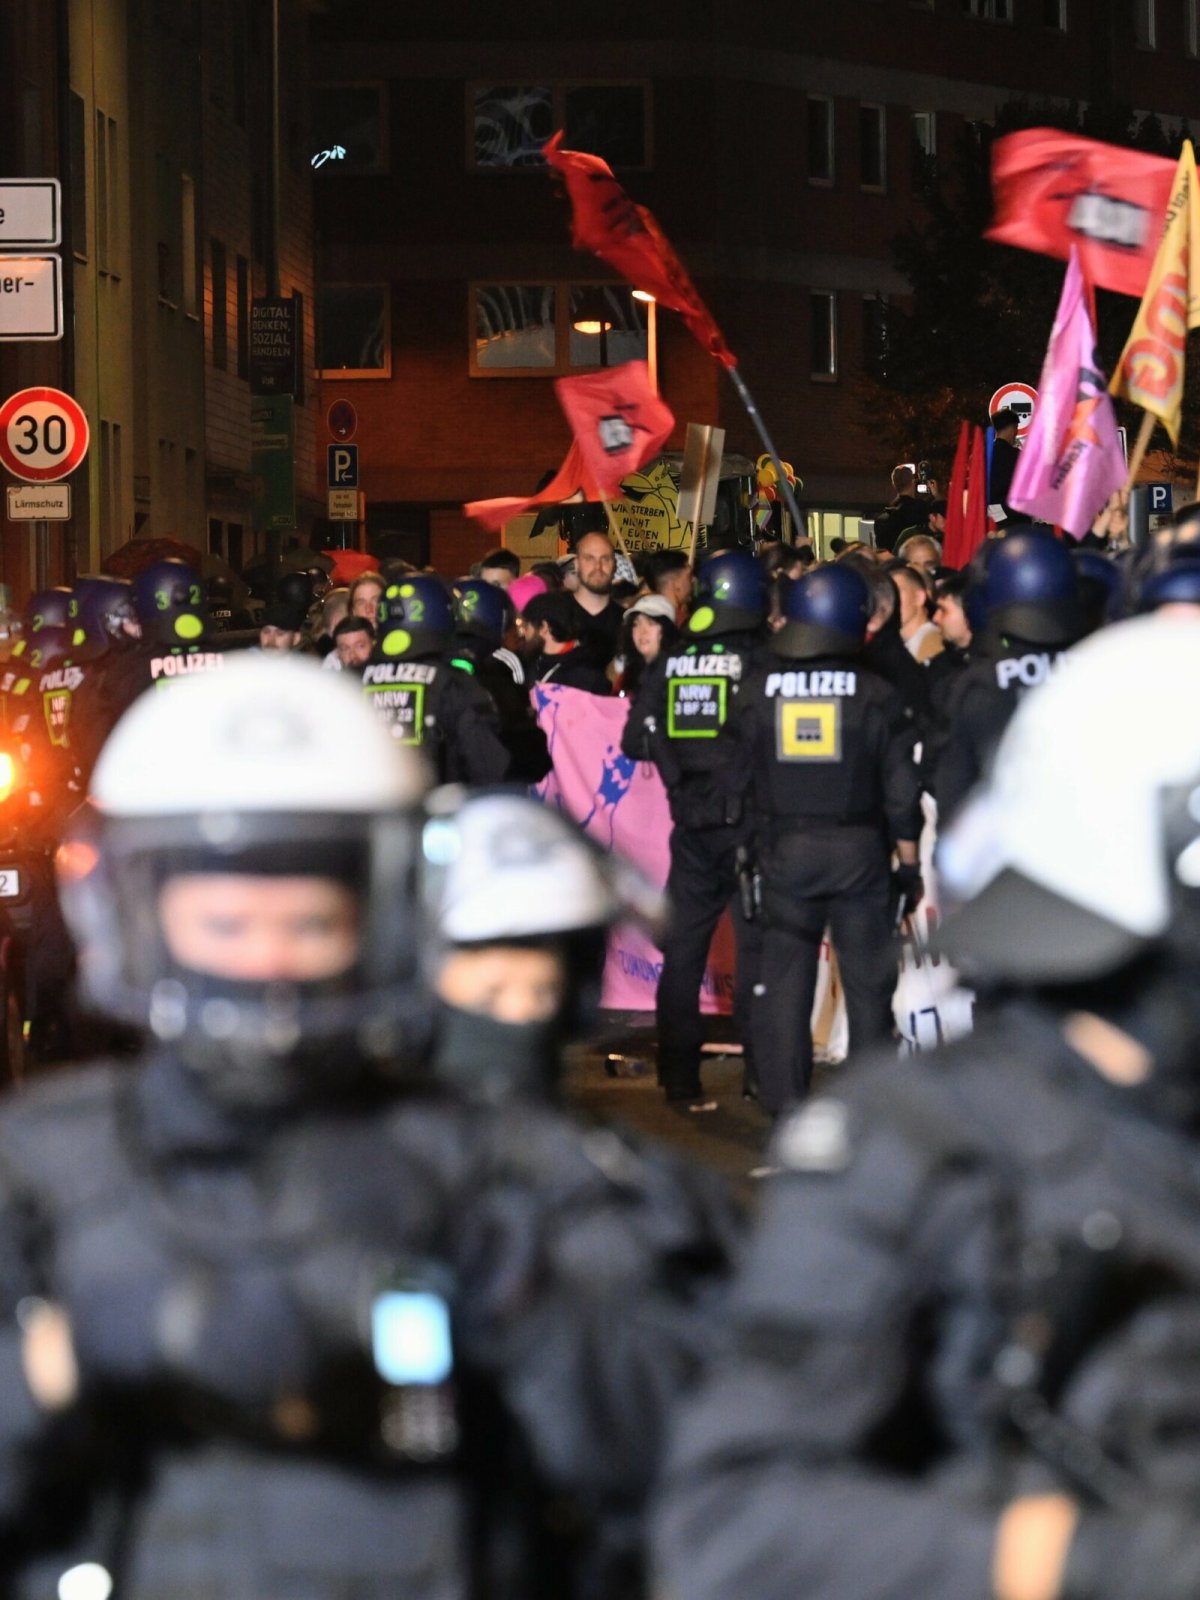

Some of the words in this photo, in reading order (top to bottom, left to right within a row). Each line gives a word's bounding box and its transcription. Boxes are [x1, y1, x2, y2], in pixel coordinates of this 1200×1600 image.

[0, 276, 34, 293] er-
[252, 306, 290, 318] DIGITAL
[252, 333, 291, 345] SOZIAL
[15, 415, 66, 455] 30
[335, 450, 351, 482] P
[15, 500, 64, 509] Lärmschutz
[1152, 486, 1167, 509] P
[631, 505, 665, 518] STERBEN
[155, 590, 171, 611] 3
[189, 584, 200, 605] 2
[408, 599, 425, 622] 2
[150, 652, 225, 679] POLIZEI
[361, 662, 437, 685] POLIZEI
[678, 685, 713, 701] NRW
[765, 671, 857, 698] POLIZEI
[374, 691, 411, 708] NRW
